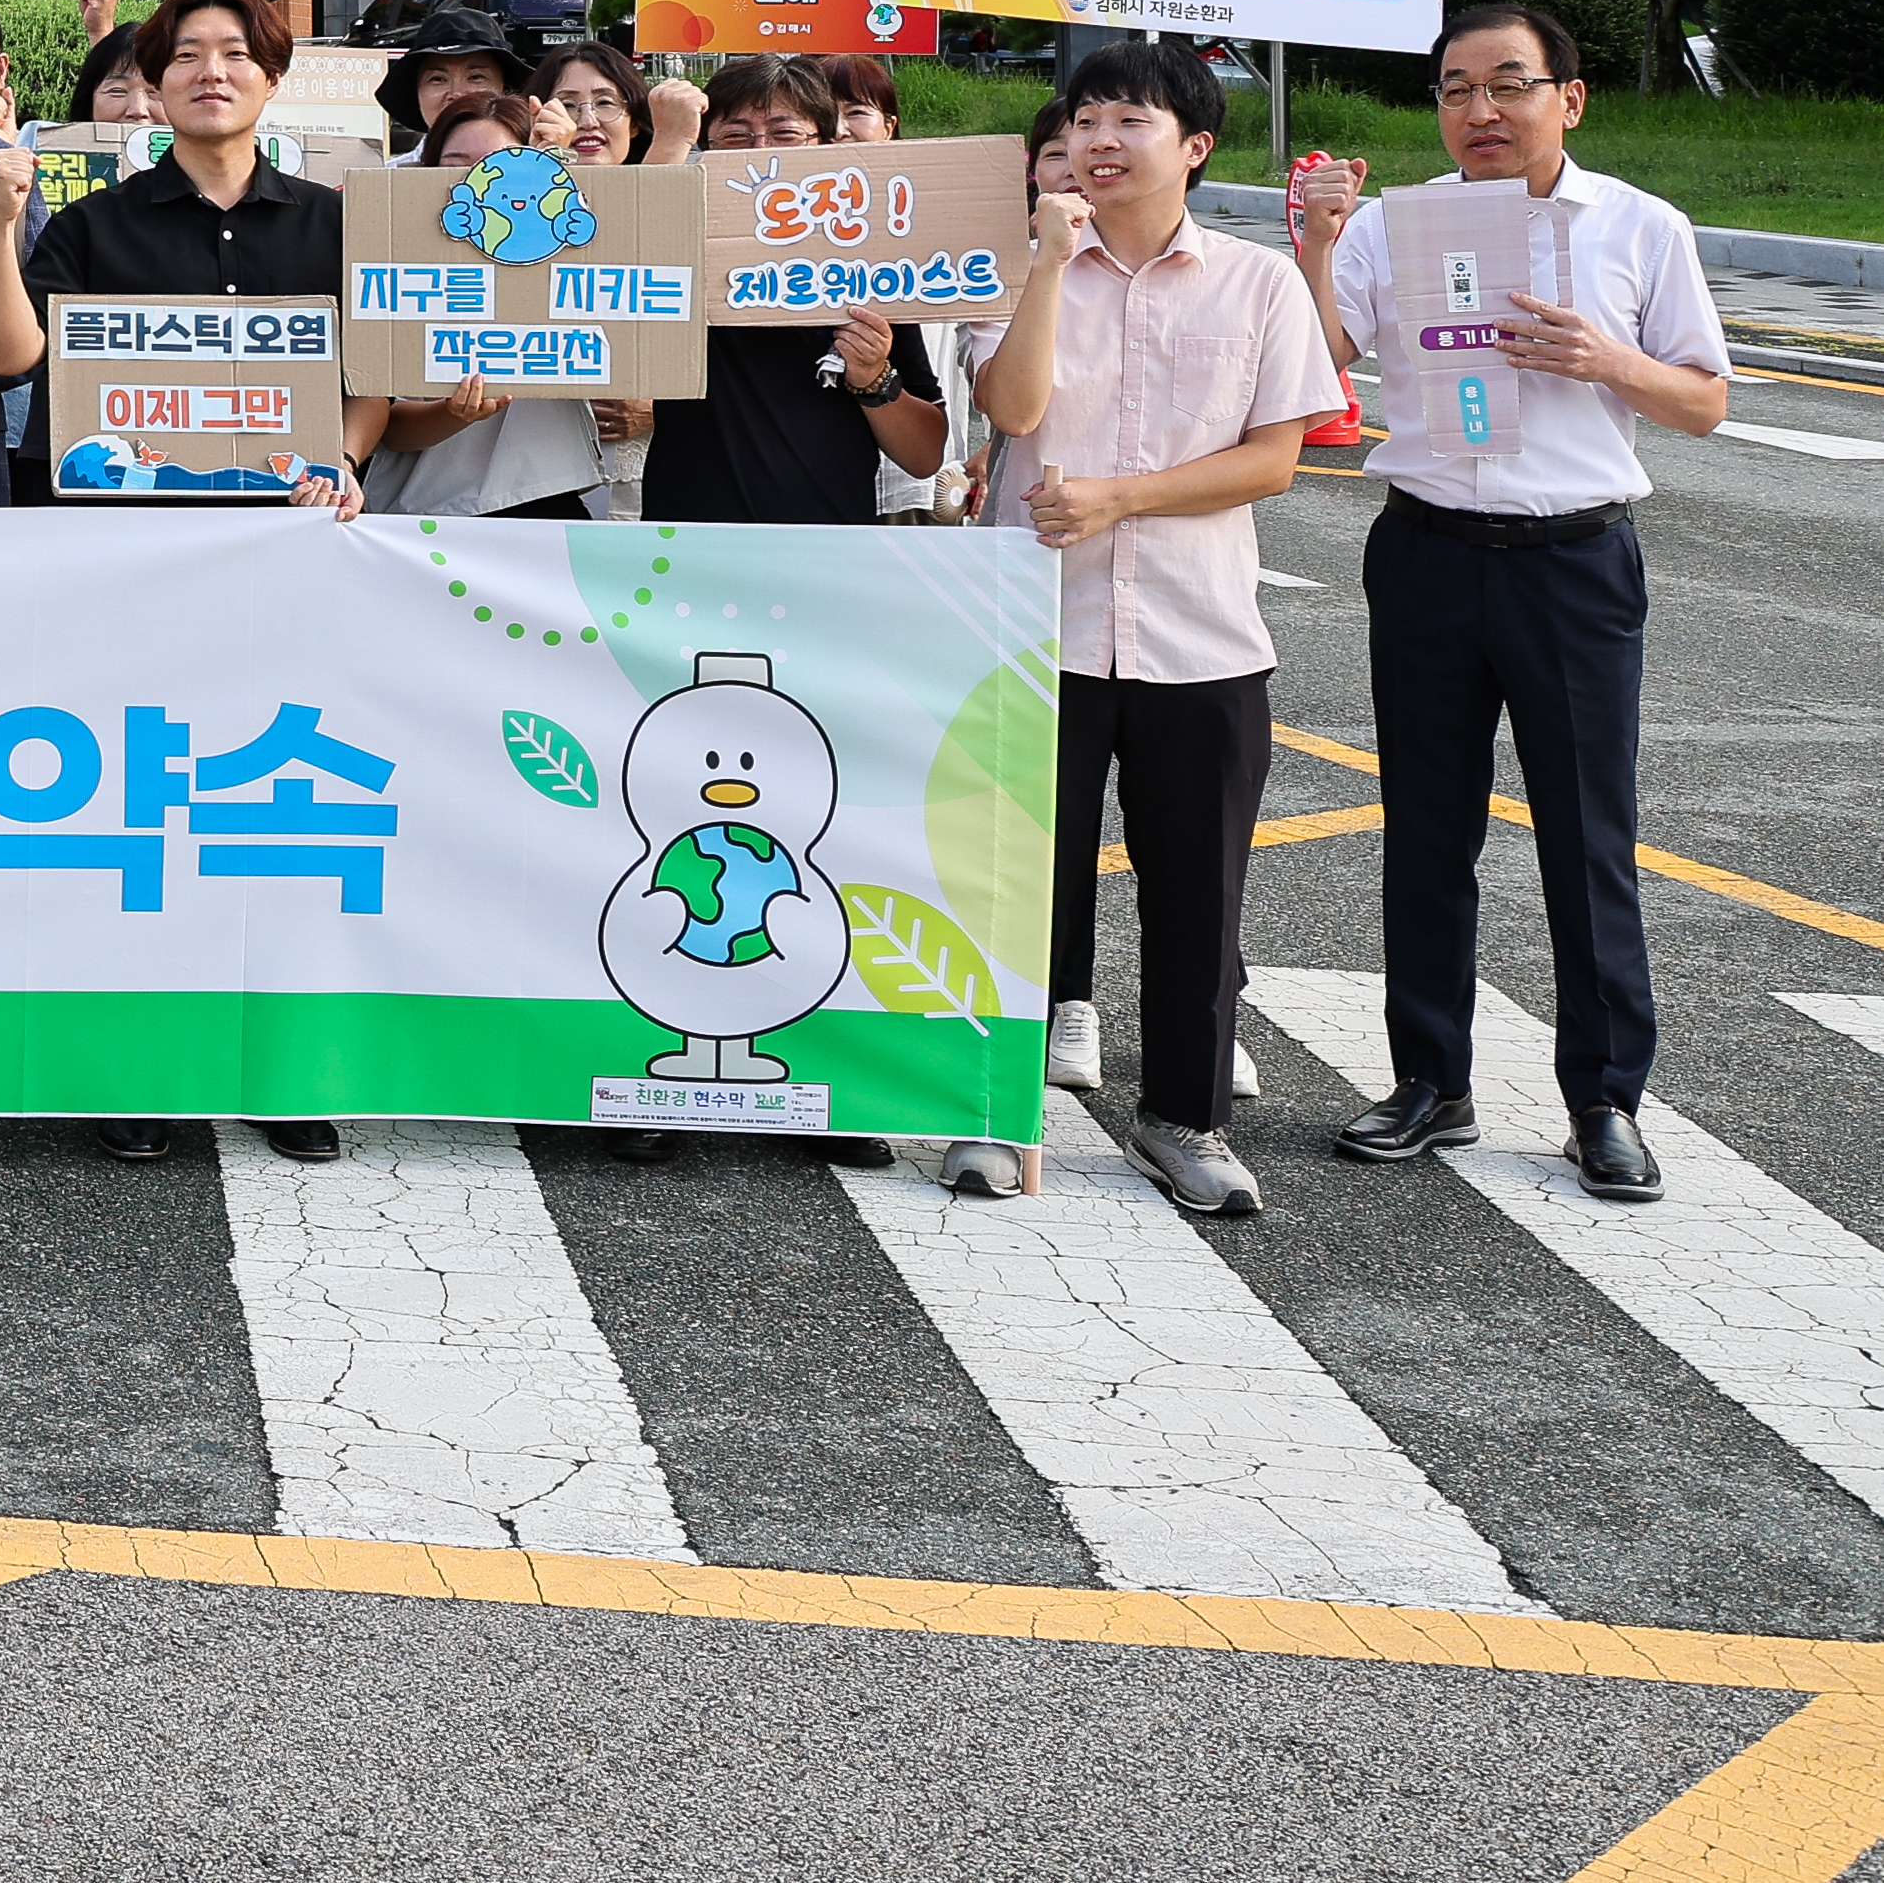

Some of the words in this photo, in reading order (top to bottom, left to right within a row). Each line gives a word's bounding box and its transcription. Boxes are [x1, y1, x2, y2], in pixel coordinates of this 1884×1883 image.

[776, 23, 812, 34] 김해시
[1149, 0, 1235, 24] 자원순환과
[310, 77, 338, 99] 이용
[342, 77, 370, 99] 안내
[37, 153, 87, 177] 우리
[38, 177, 89, 203] 함께
[761, 173, 865, 241] 도전
[359, 267, 486, 313] 지구를
[555, 267, 684, 314] 지키는
[733, 254, 999, 305] 제로웨이스트
[65, 311, 233, 354] 플라스틱
[243, 314, 327, 355] 오염
[432, 328, 603, 376] 작은실천
[106, 388, 190, 429] 이제
[201, 389, 289, 428] 그만
[635, 1084, 688, 1108] 친환경
[692, 1090, 746, 1109] 현수막
